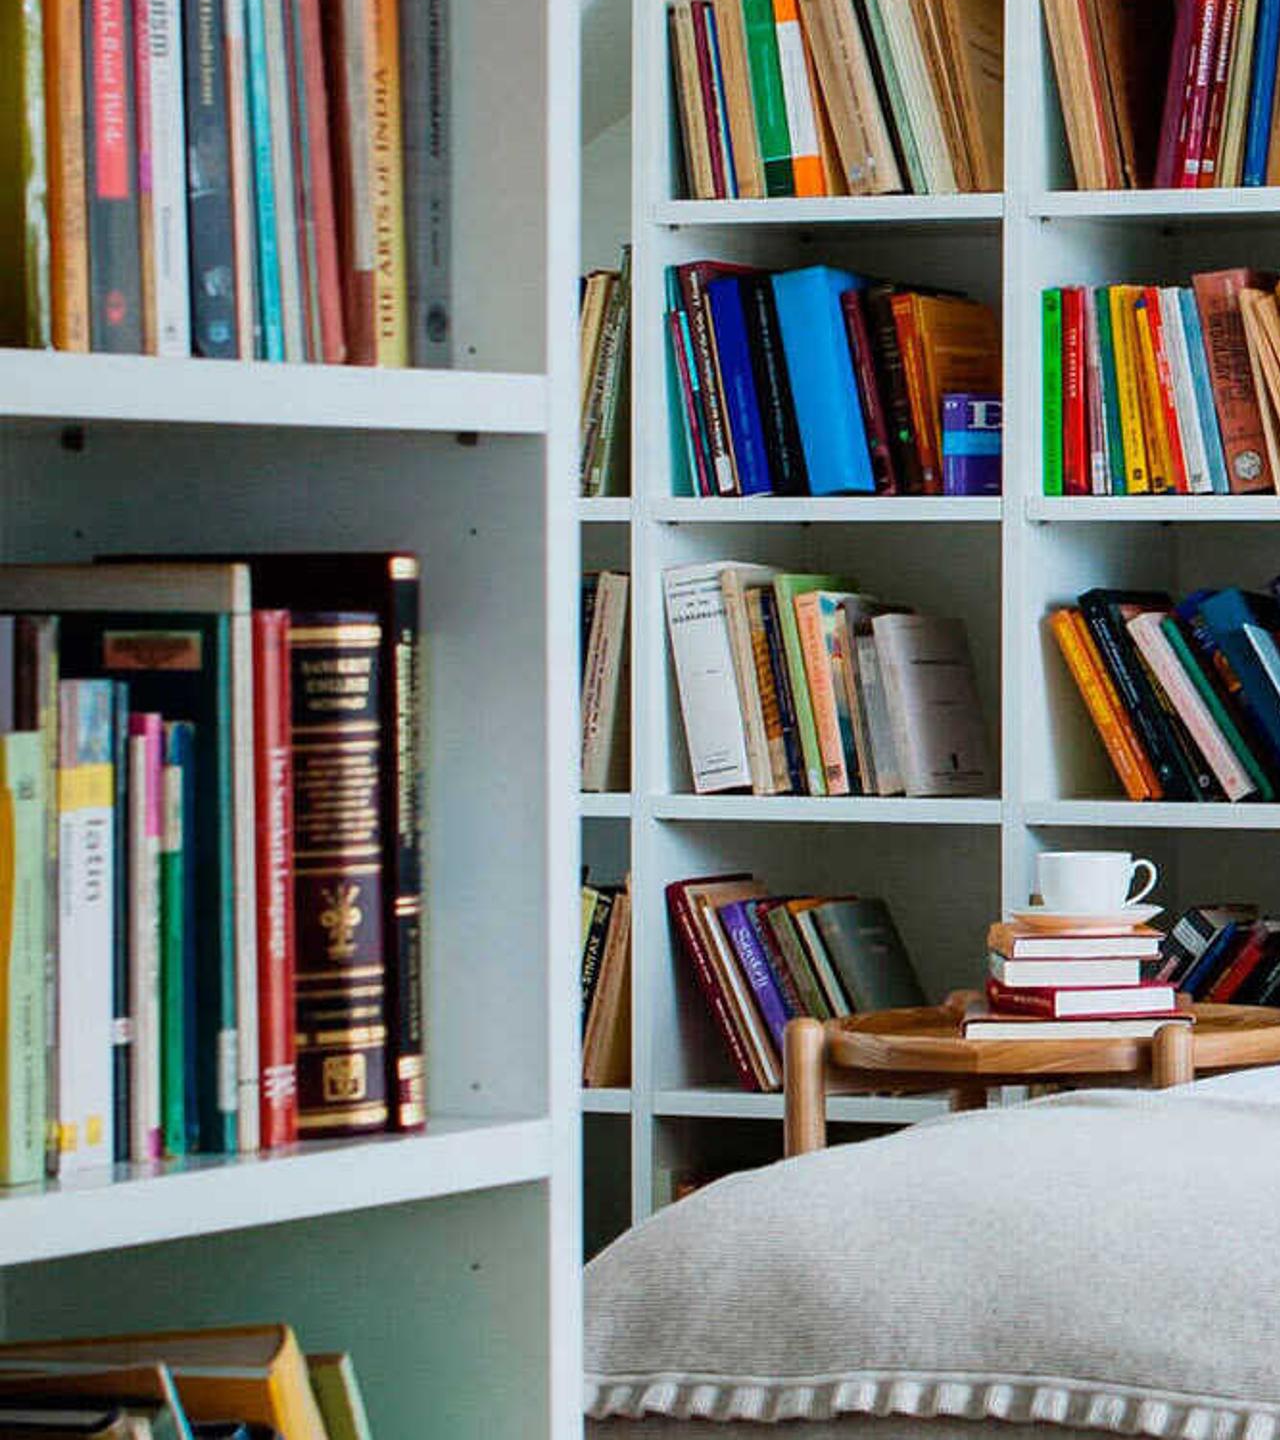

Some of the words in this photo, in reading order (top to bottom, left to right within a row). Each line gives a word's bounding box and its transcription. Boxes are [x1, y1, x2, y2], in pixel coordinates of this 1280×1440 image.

[372, 66, 389, 152] INDIA
[376, 166, 390, 198] OF
[377, 210, 393, 276] ARTS
[379, 287, 394, 338] THE
[581, 935, 601, 984] SYNTAX
